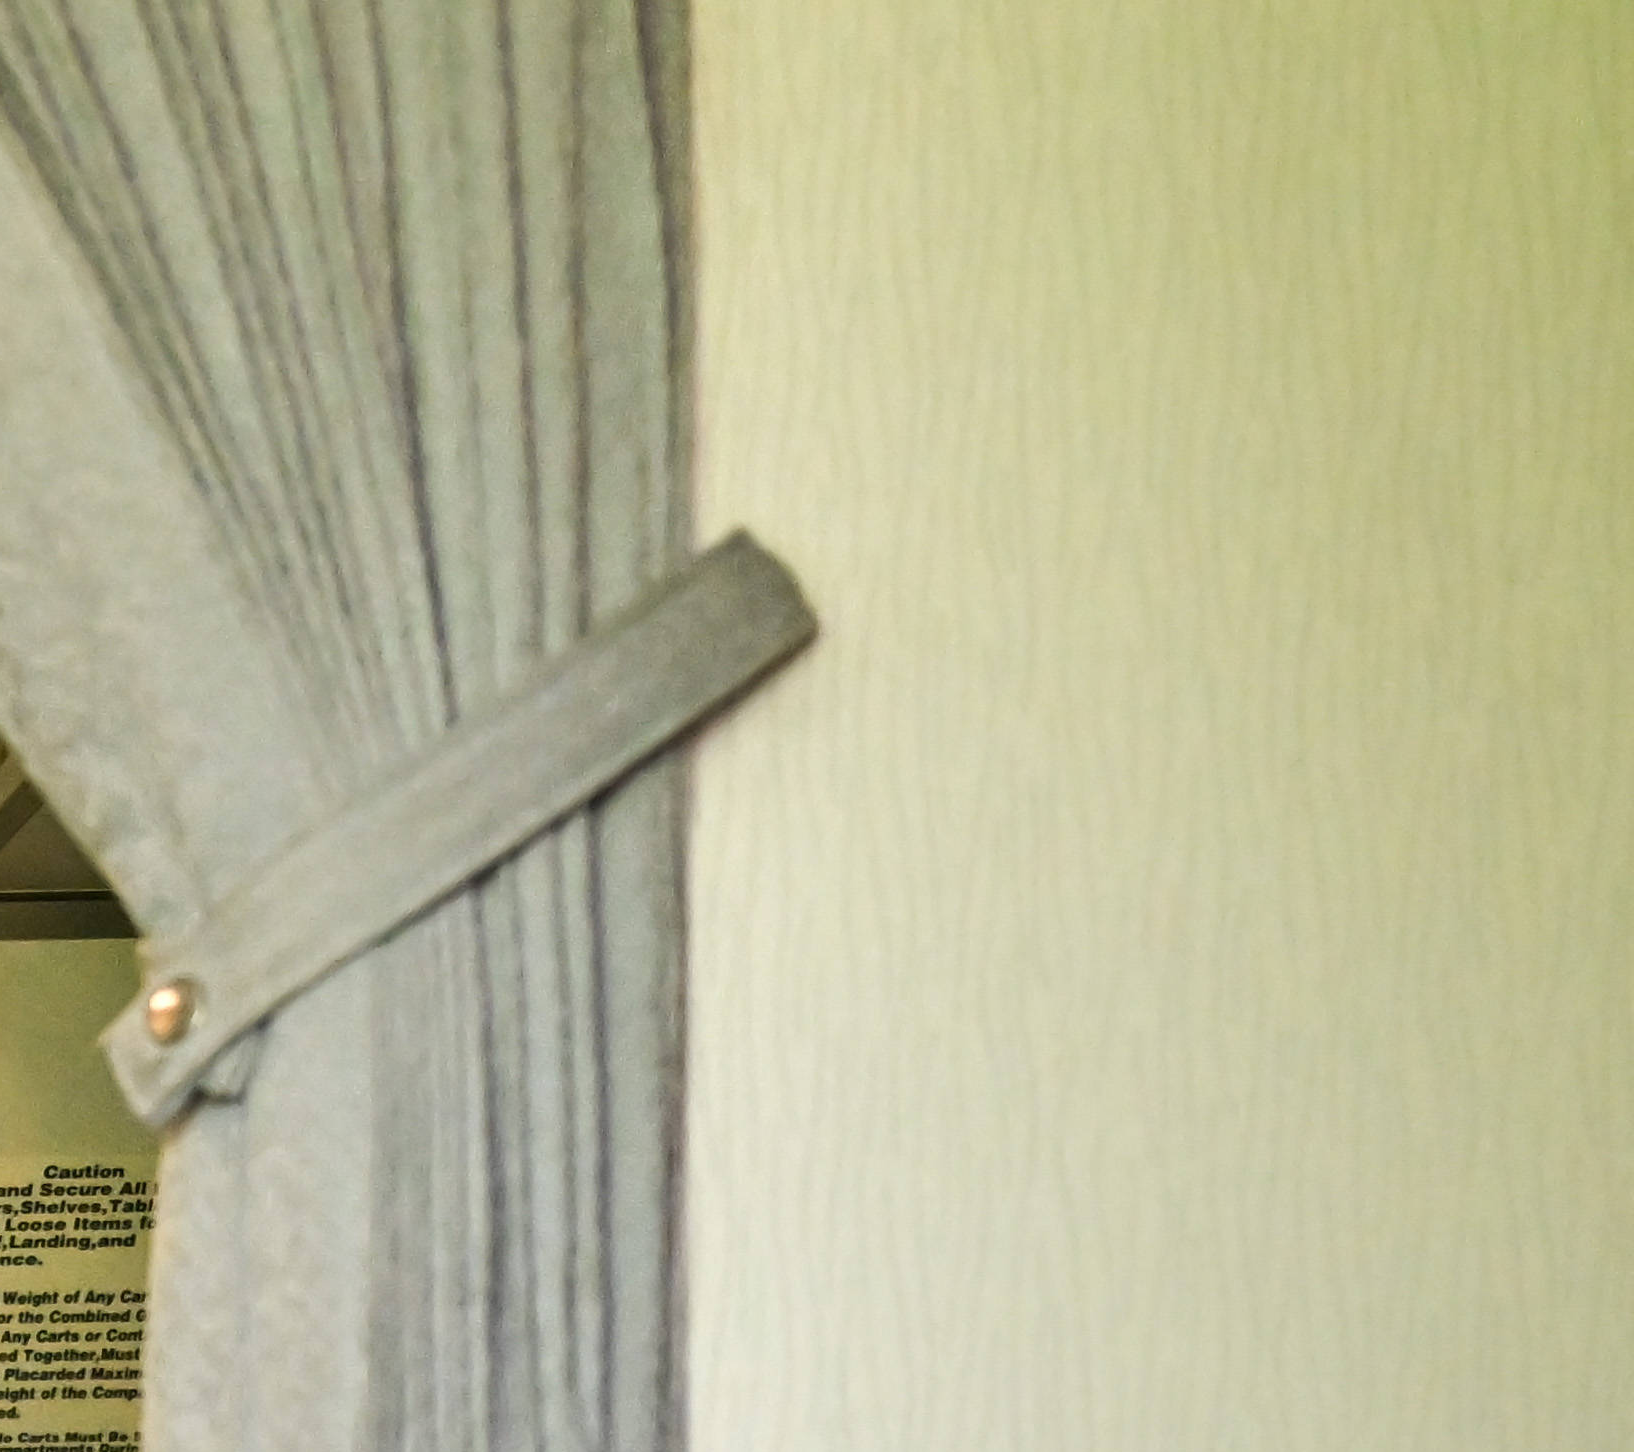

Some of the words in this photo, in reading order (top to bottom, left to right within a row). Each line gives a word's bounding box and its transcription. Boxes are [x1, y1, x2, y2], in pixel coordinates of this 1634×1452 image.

[44, 1165, 124, 1179] Caution
[40, 1183, 112, 1196] Secure
[120, 1182, 147, 1195] All
[4, 1218, 66, 1231] Loose
[74, 1217, 132, 1230] Items
[3, 1291, 58, 1307] Weight
[64, 1291, 81, 1303] of
[85, 1291, 114, 1306] Any
[19, 1312, 44, 1323] the
[49, 1310, 130, 1323] Combined
[1, 1331, 31, 1345] Any
[36, 1330, 79, 1342] Carts
[85, 1331, 101, 1341] or
[4, 1368, 85, 1381] Placarded
[41, 1387, 57, 1399] of
[62, 1387, 87, 1399] the
[93, 1386, 142, 1401] Comp
[18, 1433, 59, 1443] Carts
[65, 1432, 102, 1442] Must
